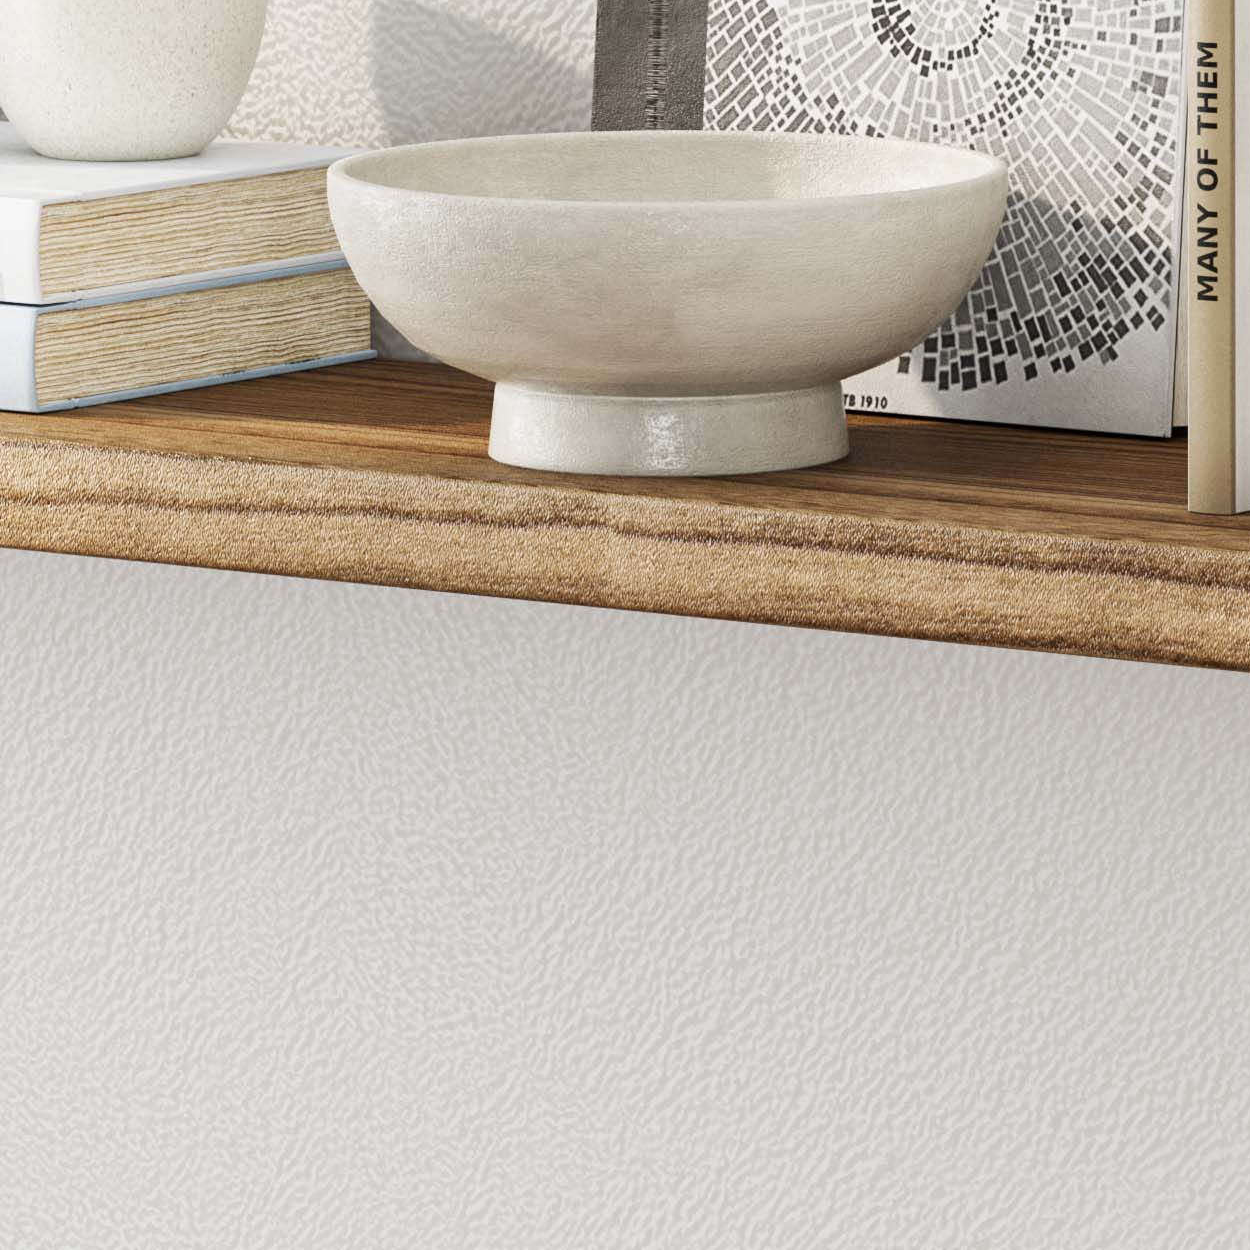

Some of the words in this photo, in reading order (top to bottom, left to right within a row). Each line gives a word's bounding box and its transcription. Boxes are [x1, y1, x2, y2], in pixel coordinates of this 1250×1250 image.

[1197, 41, 1218, 136] THEM
[1197, 148, 1218, 192] OF
[1197, 204, 1218, 302] MANY
[843, 394, 856, 407] TB
[861, 395, 888, 410] 1910
